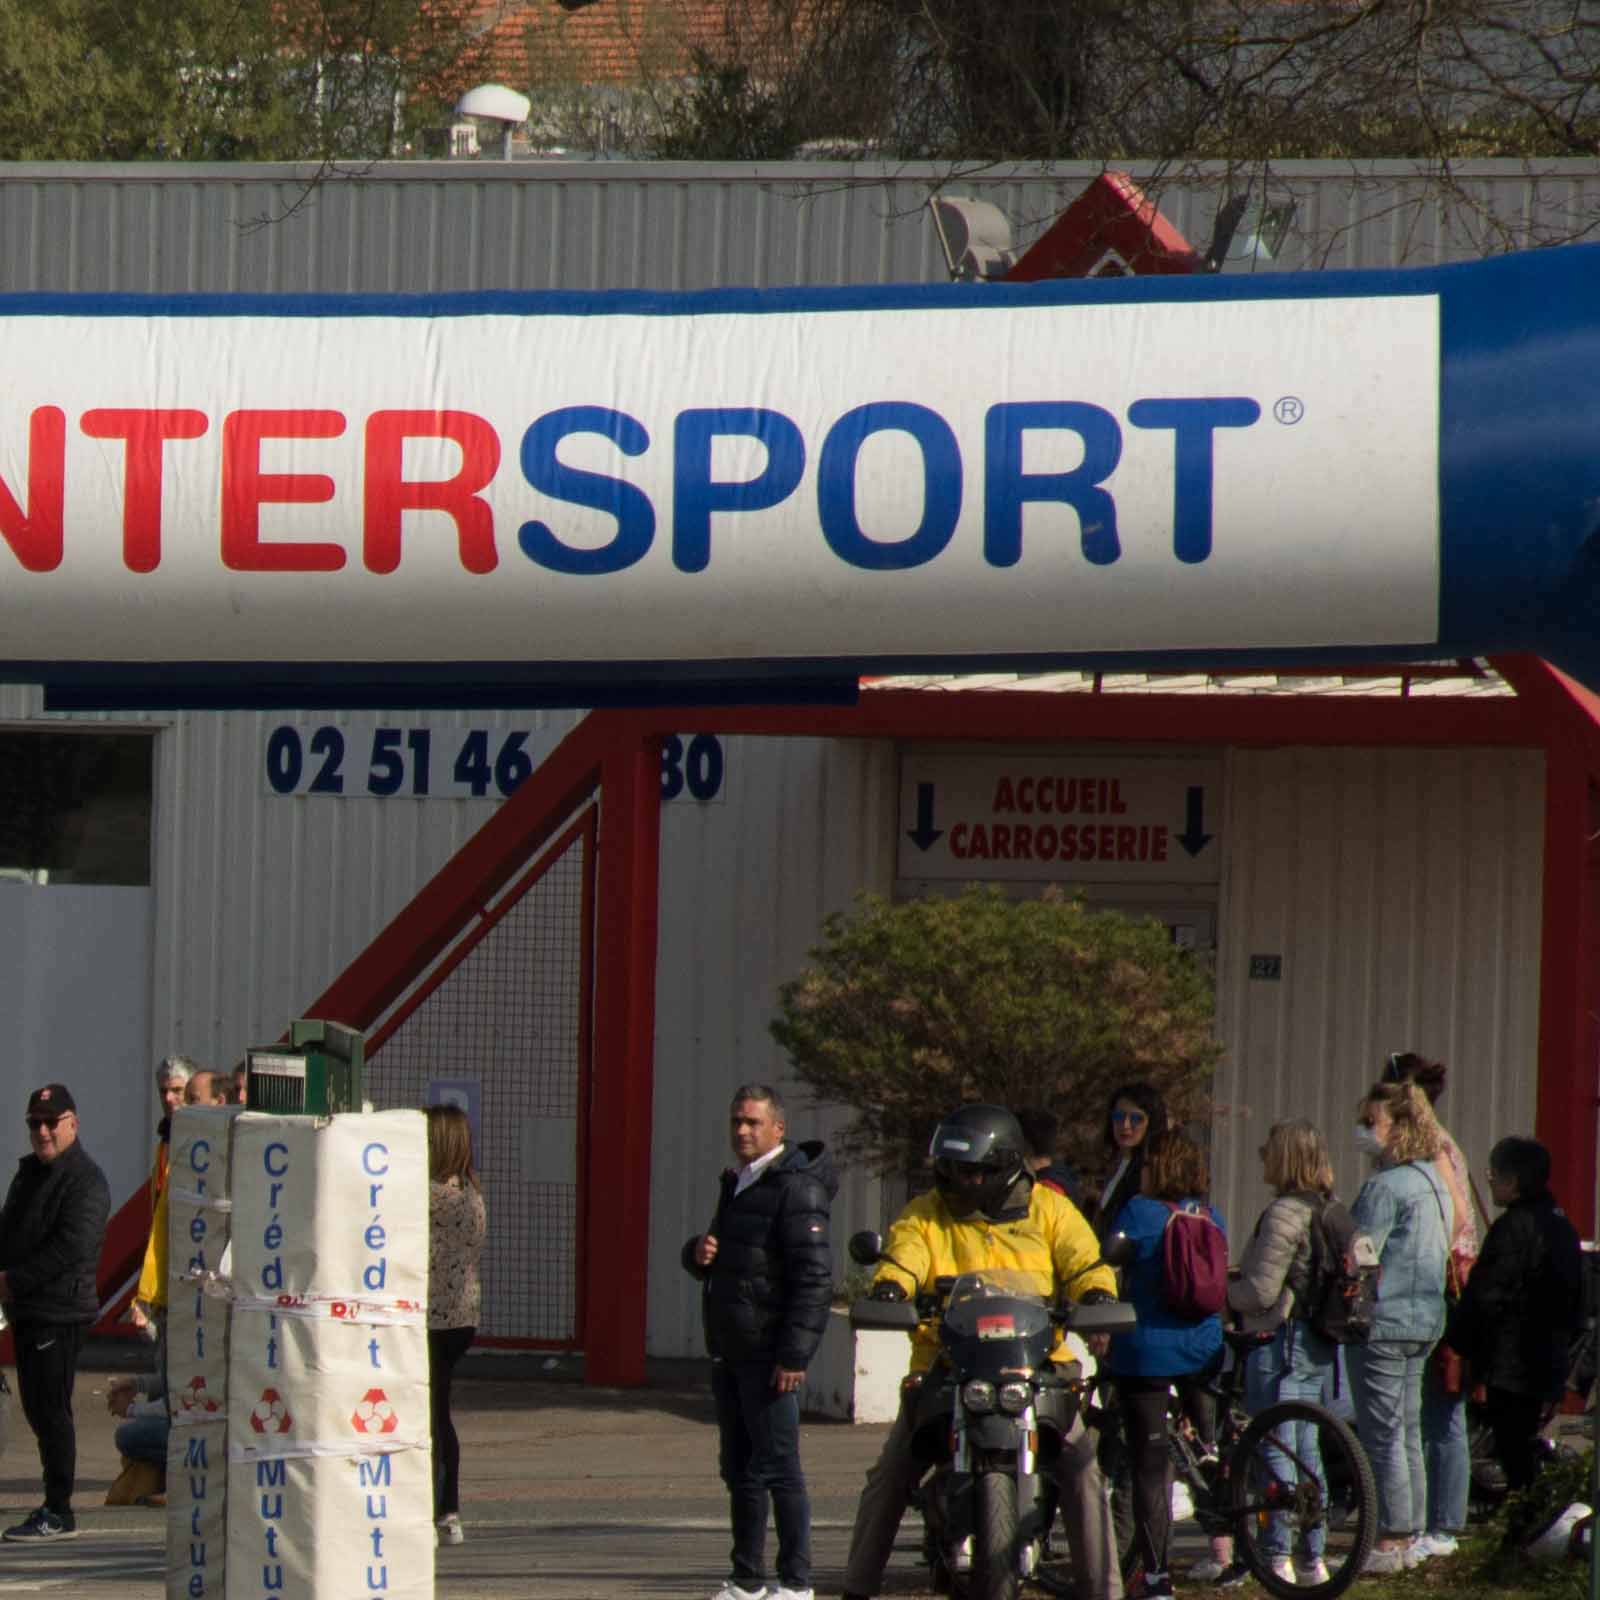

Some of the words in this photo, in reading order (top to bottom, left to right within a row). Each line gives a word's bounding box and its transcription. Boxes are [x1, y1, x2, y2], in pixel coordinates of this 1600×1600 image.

[266, 725, 345, 795] 02
[368, 728, 431, 796] 51
[991, 777, 1127, 814] ACCUEIL
[949, 823, 1169, 863] CARROSSERIE
[361, 1142, 389, 1369] Crédt
